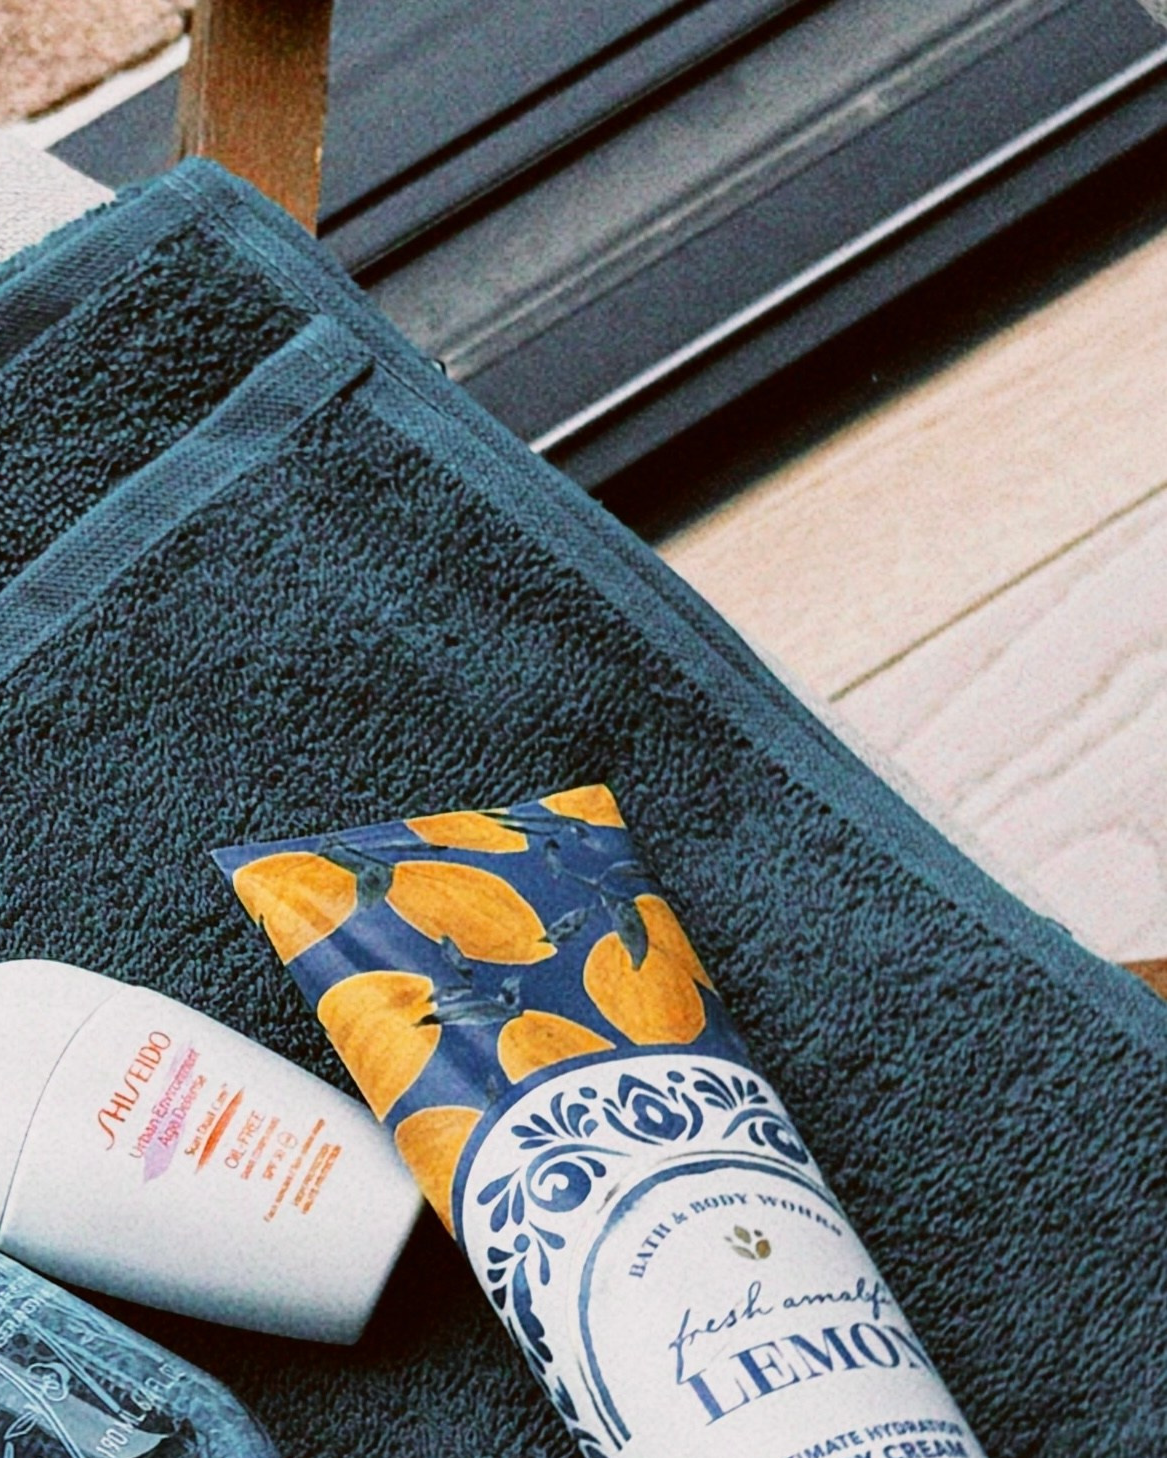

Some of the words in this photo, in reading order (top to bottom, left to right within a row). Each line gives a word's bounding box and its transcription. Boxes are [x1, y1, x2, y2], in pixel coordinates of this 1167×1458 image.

[97, 1031, 171, 1151] SHISEIDO
[129, 1118, 159, 1158] Urban
[157, 1118, 181, 1147] Age
[224, 1110, 265, 1169] OIL-FREE
[628, 1223, 671, 1278] BATH
[671, 1211, 688, 1225] &
[689, 1192, 749, 1215] BODY
[755, 1193, 843, 1238] WORKS
[668, 1280, 774, 1385] fresh
[687, 1321, 936, 1426] LEMON
[96, 1428, 128, 1458] 190
[114, 1408, 148, 1434] ML
